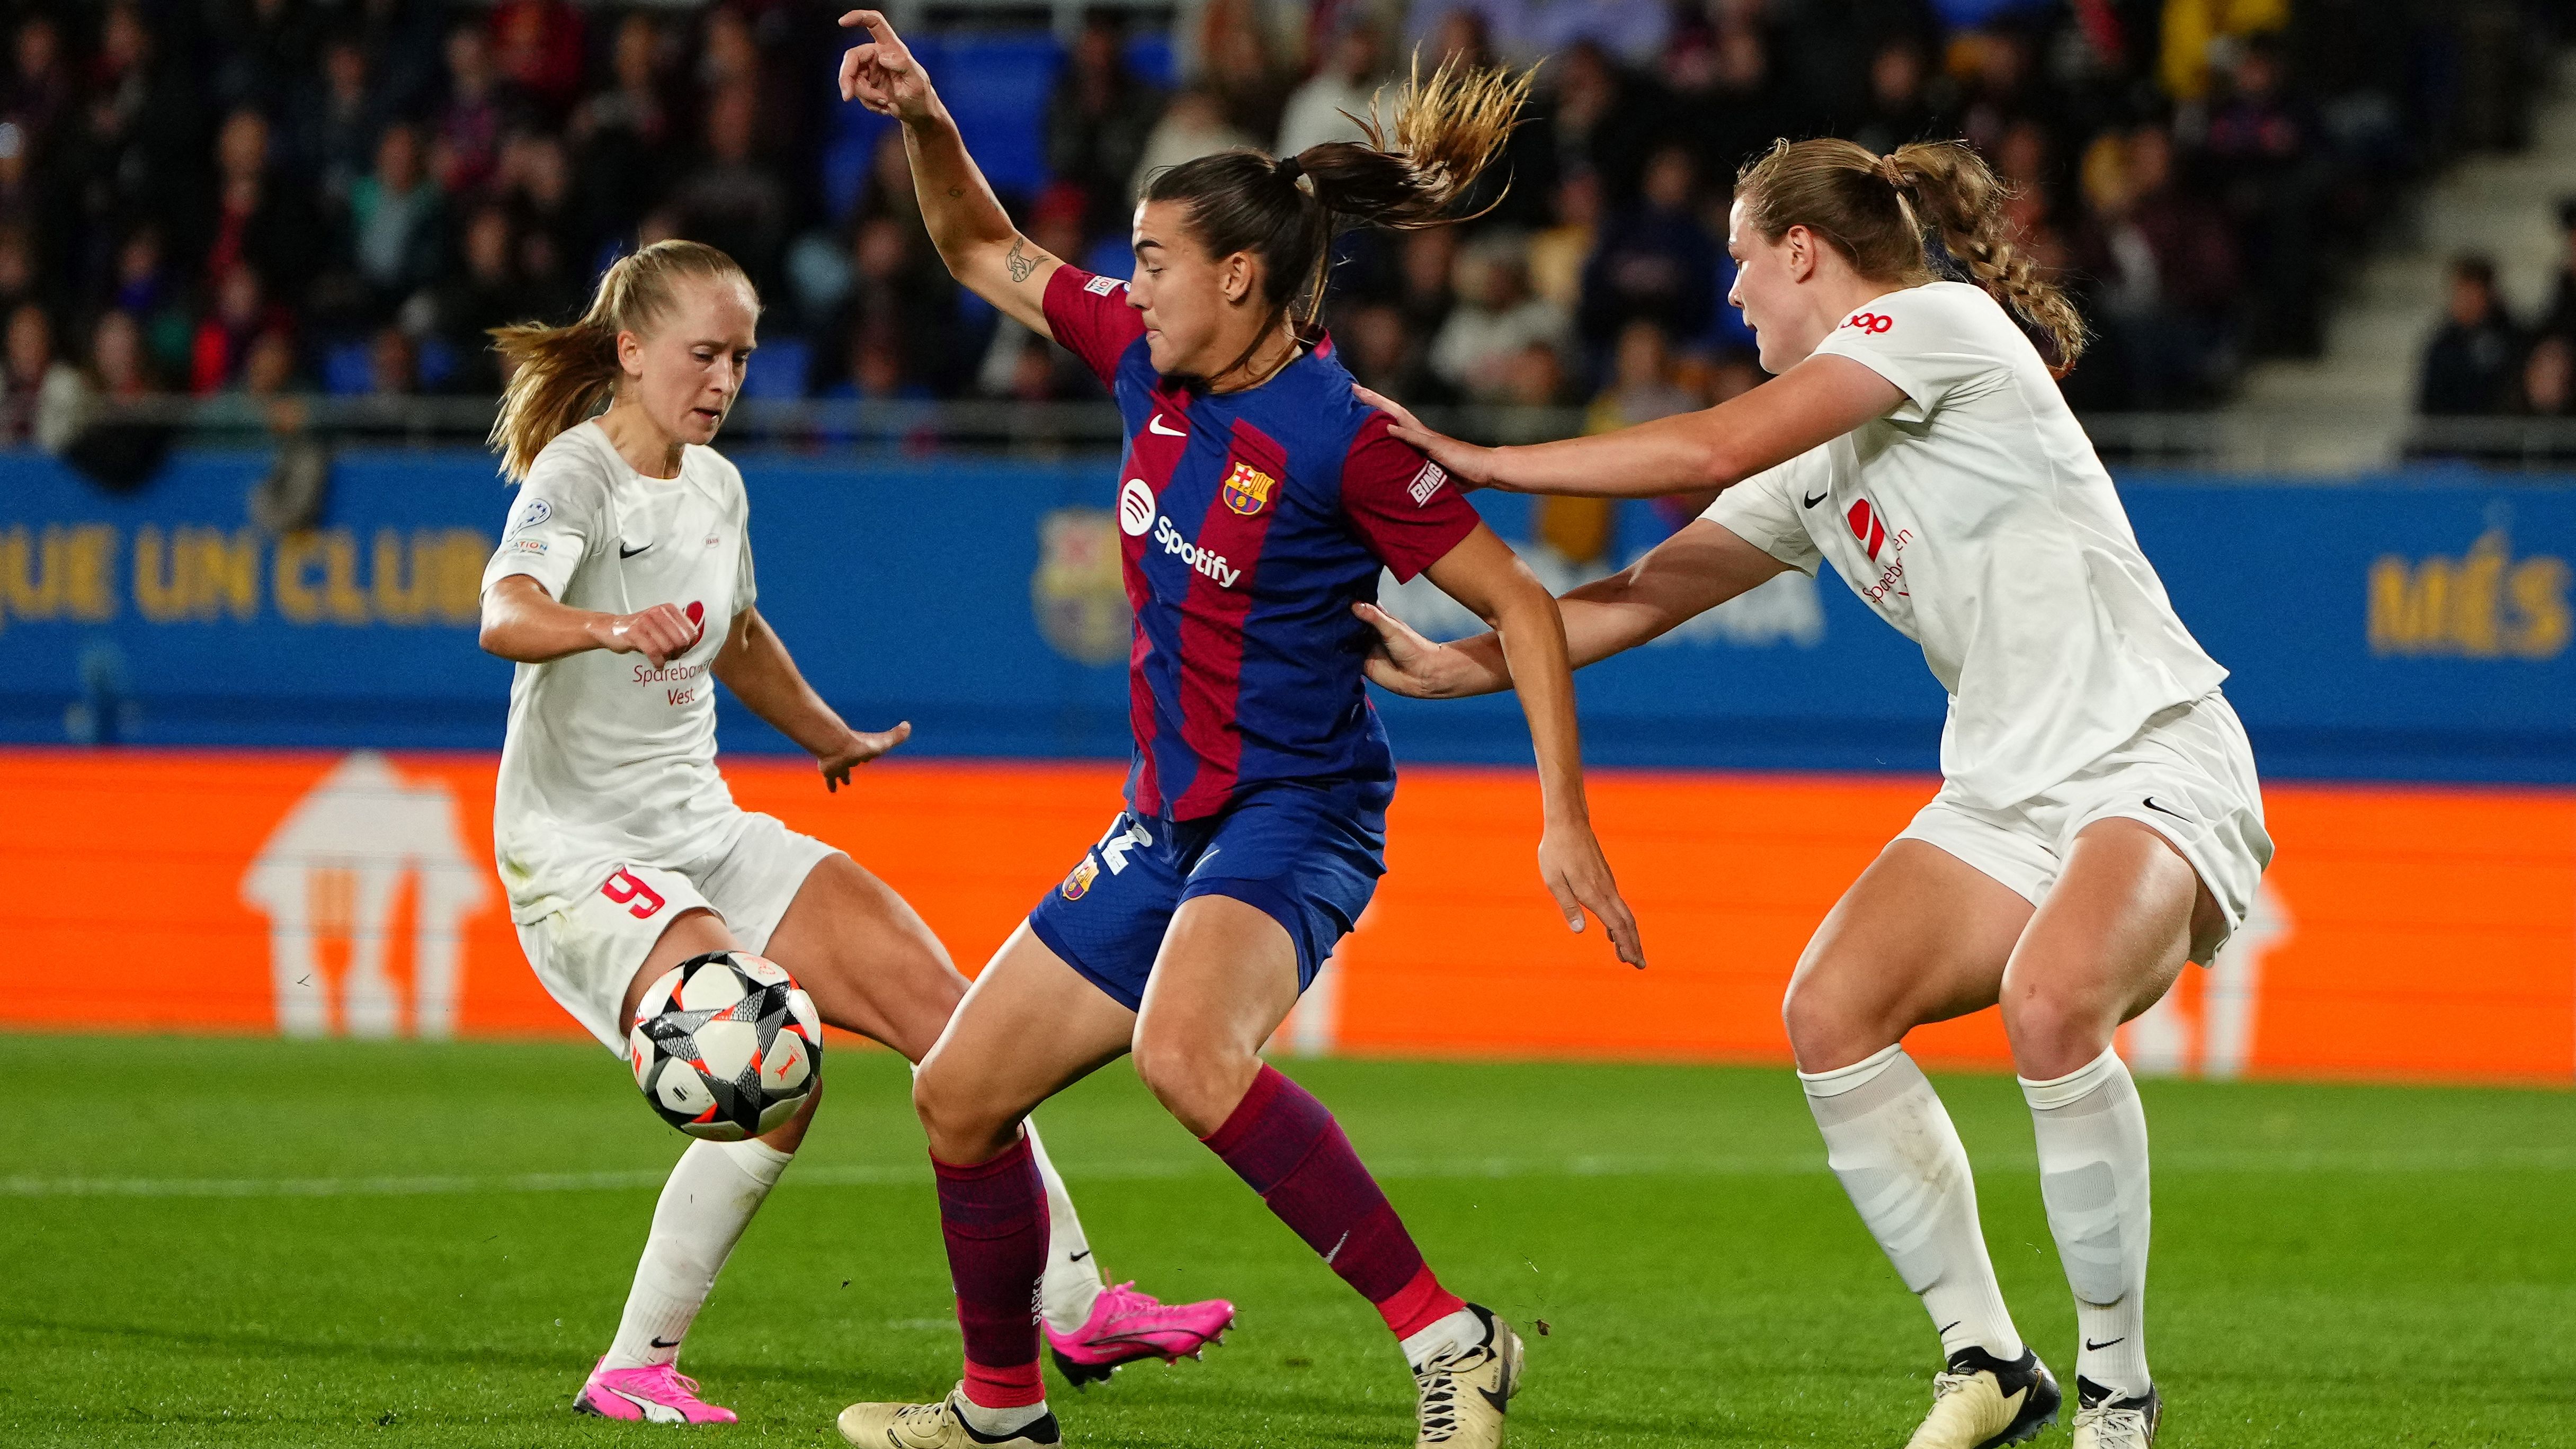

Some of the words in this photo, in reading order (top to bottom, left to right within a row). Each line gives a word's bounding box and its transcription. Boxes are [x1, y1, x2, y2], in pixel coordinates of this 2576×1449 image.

[1410, 462, 1443, 503] BIMB
[1154, 515, 1241, 587] Spotify
[667, 686, 694, 706] Vest
[601, 864, 665, 919] 9
